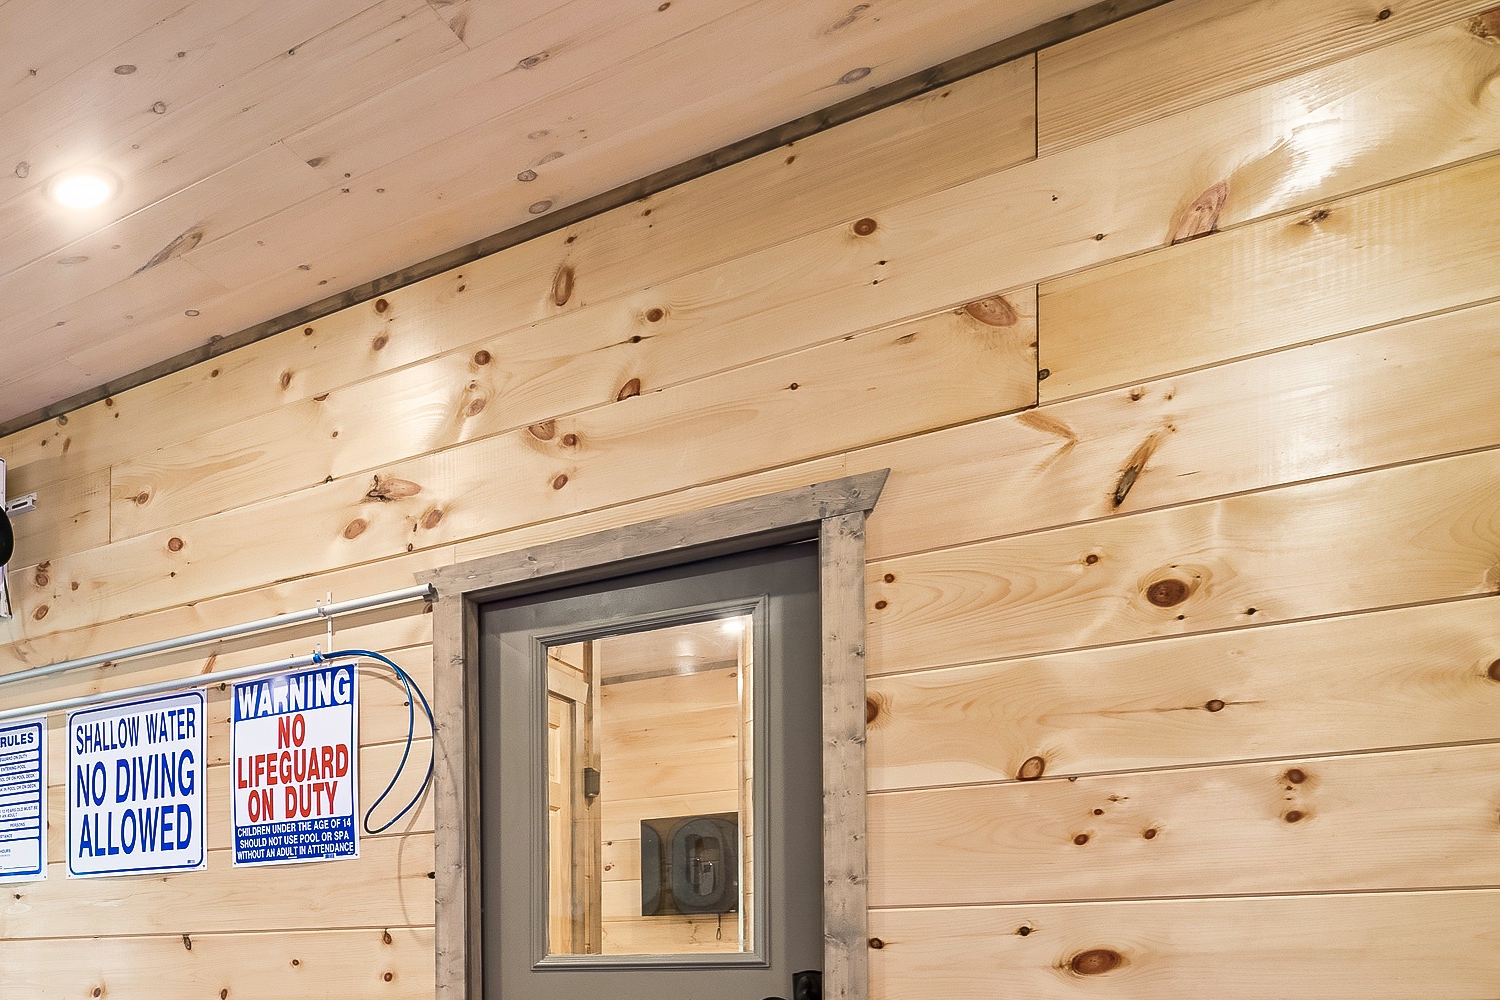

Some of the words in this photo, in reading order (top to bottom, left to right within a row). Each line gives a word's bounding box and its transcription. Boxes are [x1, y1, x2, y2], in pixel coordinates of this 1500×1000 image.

[238, 669, 351, 719] WARNING
[0, 733, 34, 748] RULES
[76, 716, 139, 755] SHALLOW
[146, 708, 195, 744] WATER
[278, 714, 305, 749] NO
[77, 761, 107, 808] NO
[116, 749, 194, 803] DIVING
[238, 744, 348, 789] LIFEGUARD
[248, 788, 274, 823] ON
[285, 781, 338, 818] DUTY
[79, 804, 192, 858] ALLOWED
[238, 827, 270, 837] CHILDREN
[272, 824, 296, 834] UNDER
[298, 822, 312, 830] THE
[314, 821, 329, 829] AGE
[331, 819, 341, 828] OF
[343, 818, 351, 827] 14
[240, 837, 267, 848] SHOULD
[269, 836, 282, 845] NOT
[284, 836, 298, 844] USE
[300, 833, 321, 843] POOL
[322, 832, 333, 841] OR
[334, 830, 349, 840] SPA
[237, 848, 264, 860] WITHOUT
[266, 848, 275, 857] AN
[277, 846, 298, 857] ADULT
[299, 846, 306, 855] IN
[308, 842, 354, 854] ATTENDANCE
